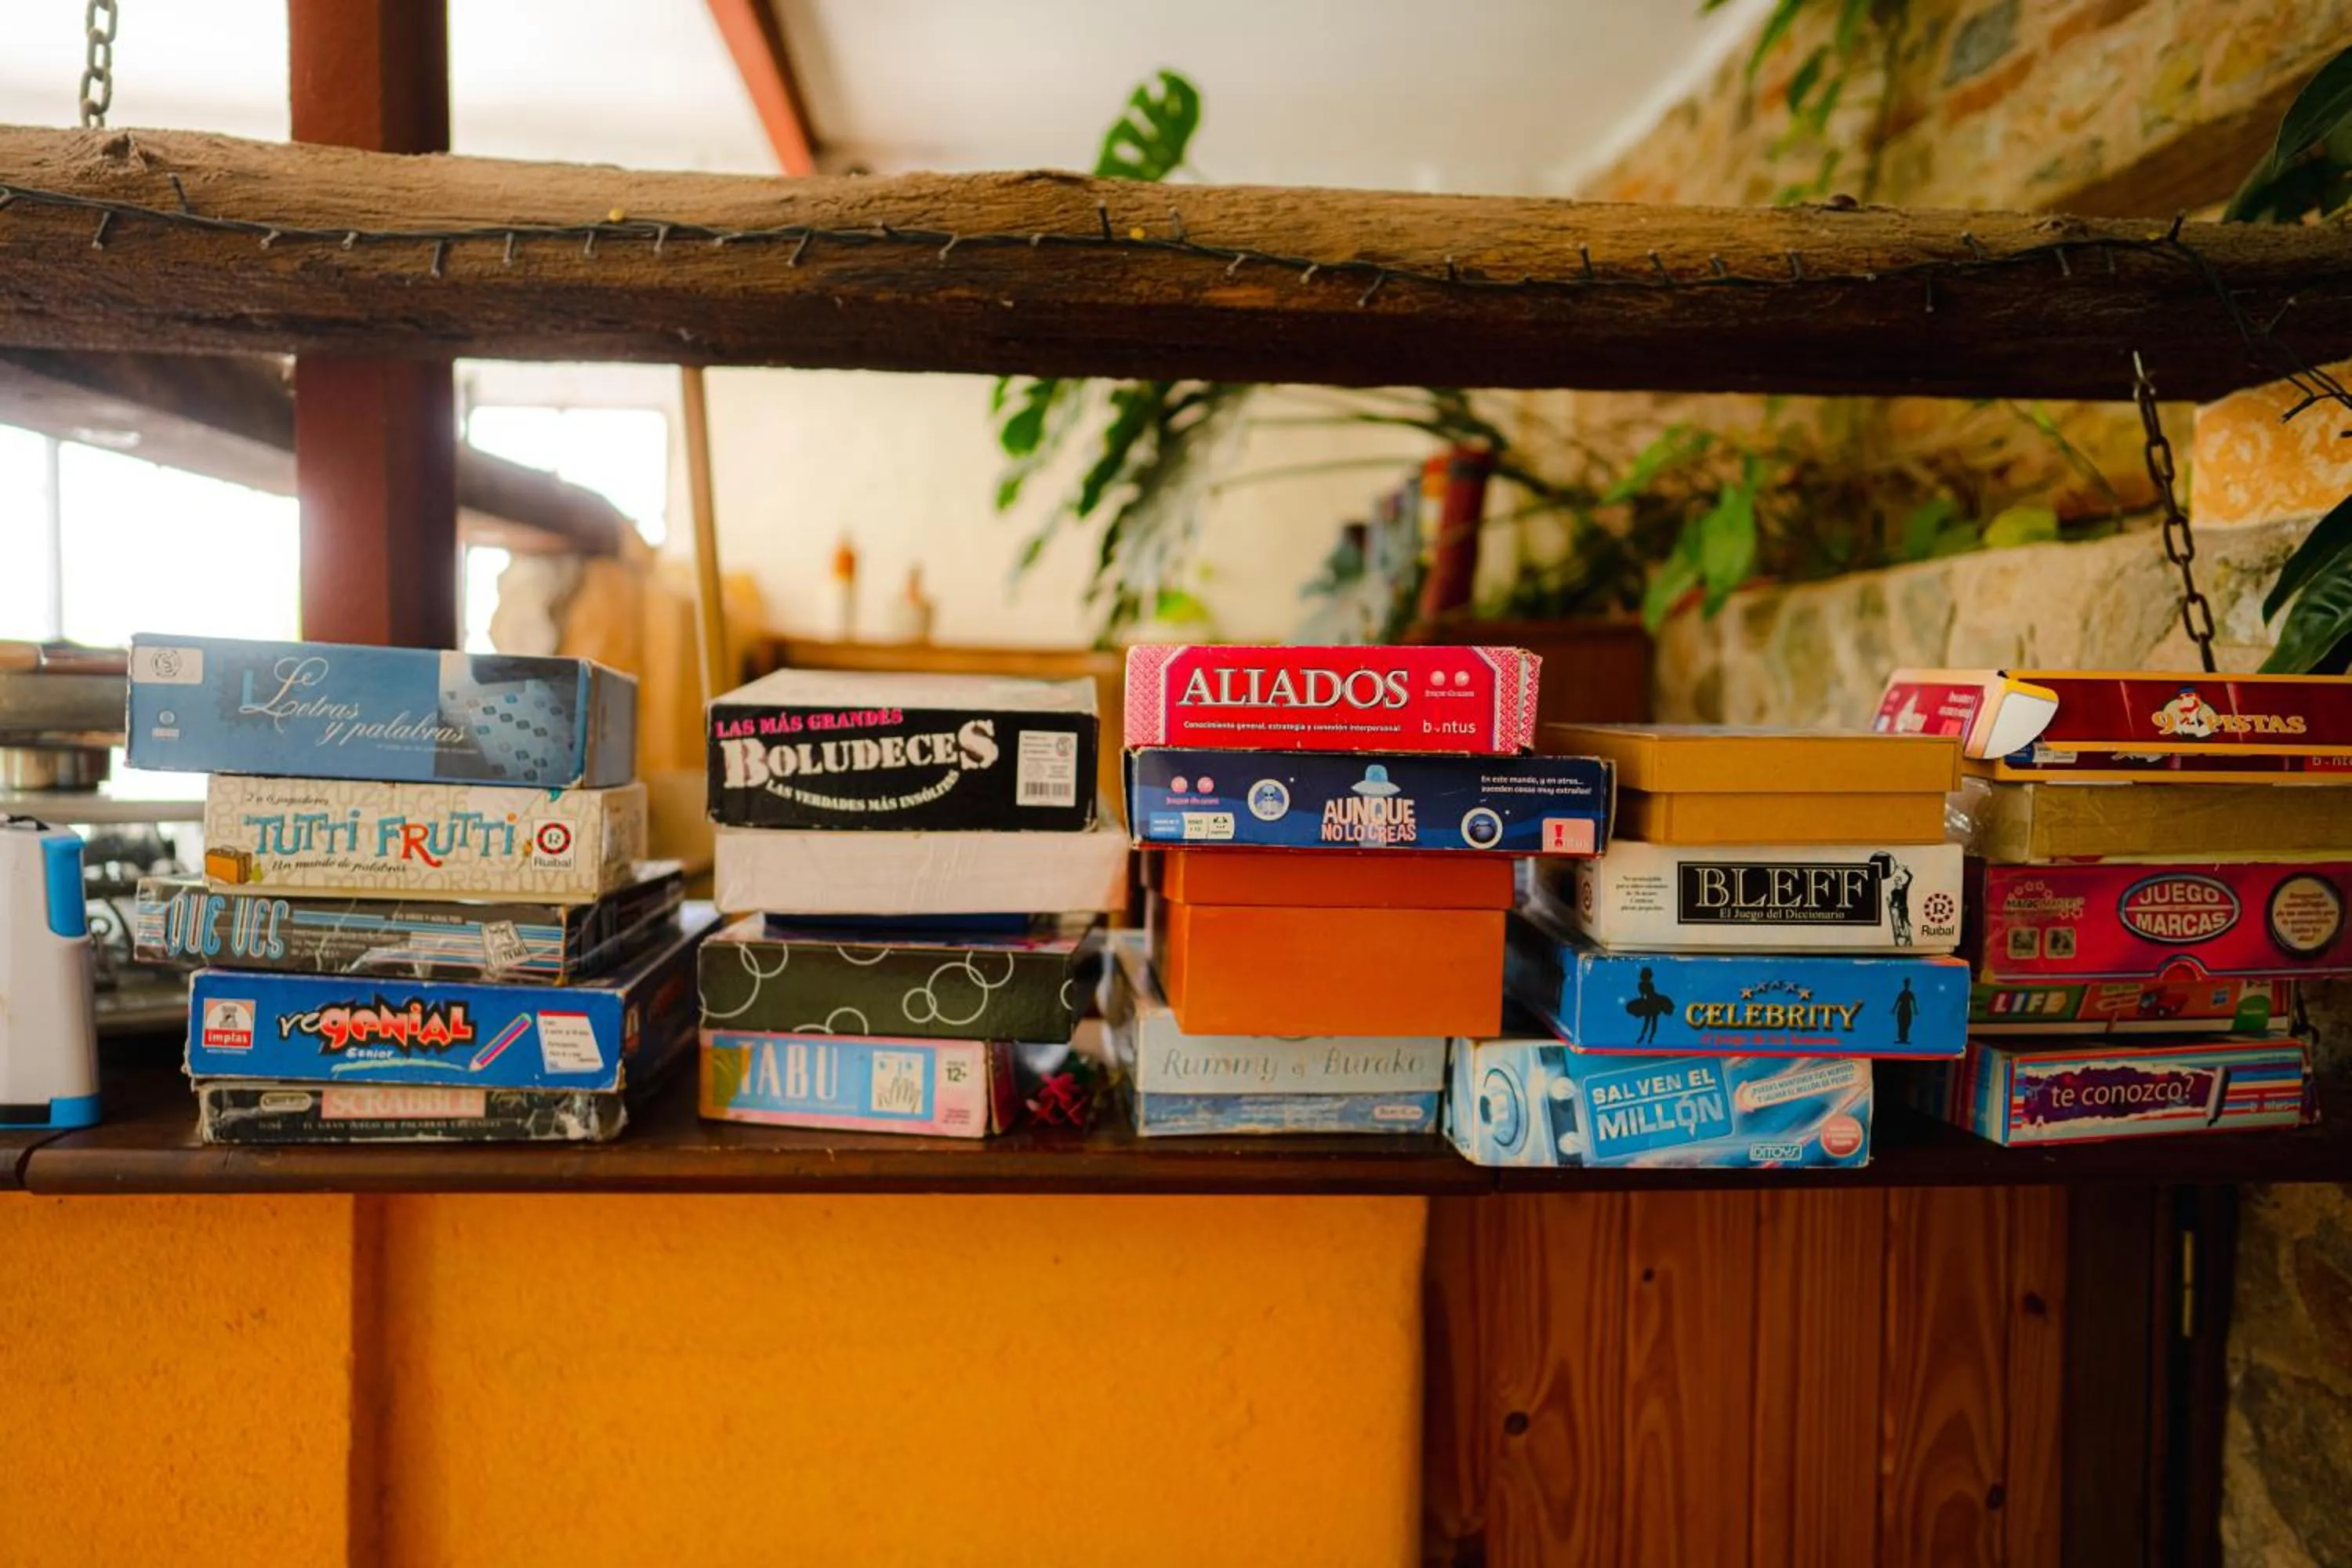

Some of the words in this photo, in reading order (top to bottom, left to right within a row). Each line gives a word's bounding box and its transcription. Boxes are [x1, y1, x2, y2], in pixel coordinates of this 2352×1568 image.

[238, 657, 360, 733] Letras
[1177, 667, 1410, 710] ALIADOS
[316, 718, 344, 746] y
[339, 710, 465, 746] palabras
[715, 717, 755, 739] LAS
[760, 713, 803, 735] MÁS
[807, 707, 904, 730] GRANDES
[2151, 711, 2175, 735] 9
[2205, 713, 2307, 735] PISTAS
[720, 719, 1000, 789] BOLUDECES
[765, 779, 792, 799] LAS
[795, 789, 866, 811] VERDADES
[868, 795, 898, 811] MÁS
[1323, 796, 1416, 826] AUNQUE
[243, 810, 361, 855] TUTTI
[375, 811, 517, 868] FRUTTI
[1321, 824, 1343, 841] NO
[1345, 824, 1365, 841] LO
[1367, 823, 1417, 843] CREAS
[352, 862, 407, 873] palabras
[1695, 868, 1869, 908] BLEFF
[2138, 882, 2220, 906] JUEGO
[1719, 909, 1729, 920] El
[1733, 909, 1764, 922] Juego
[1766, 909, 1784, 920] del
[1785, 909, 1846, 920] Diccionario
[1922, 924, 1955, 936] Ruibal
[2136, 911, 2227, 936] MARCAS
[1686, 1000, 1864, 1030] CELEBRITY
[1994, 991, 2067, 1014] LIFE
[736, 1040, 839, 1101] TABU
[946, 1067, 968, 1082] 12+
[1160, 1048, 1279, 1082] Rummy
[1323, 1047, 1425, 1078] Burako
[331, 1090, 479, 1113] SCRABBLE
[1592, 1074, 1682, 1105] SALVEN
[1687, 1068, 1717, 1087] EL
[2051, 1085, 2076, 1108] te
[2082, 1075, 2195, 1106] conozco?
[1596, 1093, 1725, 1142] MILLÓN
